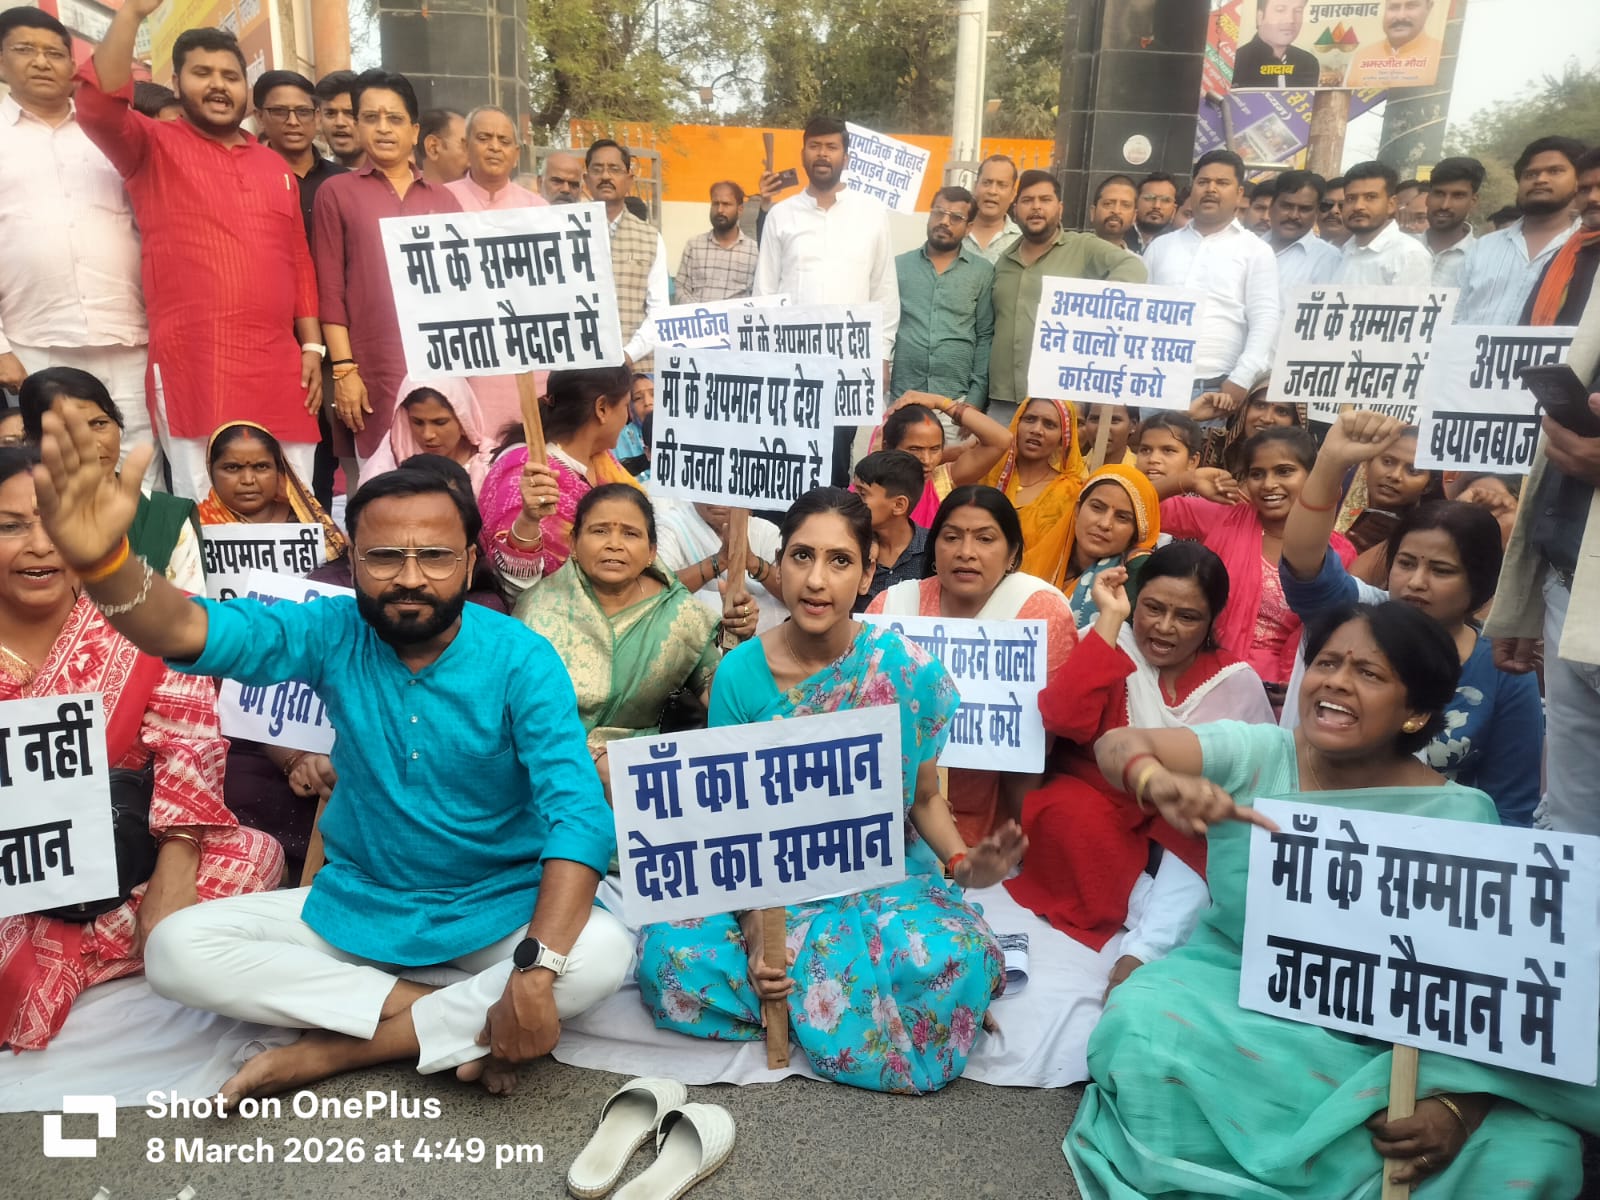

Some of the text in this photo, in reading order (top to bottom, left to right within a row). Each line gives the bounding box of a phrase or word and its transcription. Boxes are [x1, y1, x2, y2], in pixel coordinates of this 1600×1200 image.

[1310, 3, 1380, 23] मुबारकबाद
[400, 211, 596, 294] माँ के सम्मान में
[418, 293, 604, 371] जनता मैदान में
[826, 323, 843, 359] पर
[846, 311, 871, 359] देश
[1051, 288, 1196, 326] अमर्यादित बयान
[1294, 291, 1448, 344] माँ के सम्मान में
[1040, 321, 1069, 353] देने
[1072, 326, 1123, 357] वालों
[1123, 335, 1148, 360] पर
[661, 356, 824, 429] माँ के अपमान पर देश
[862, 368, 875, 416] है
[1058, 361, 1166, 398] कार्रवाई करो
[1284, 350, 1430, 400] जनता मैदान में
[656, 428, 823, 501] की जनता आक्रोशित है
[205, 528, 319, 574] अपमान नहीं
[950, 626, 991, 681] करने
[994, 626, 1039, 682] वालों
[18, 699, 94, 782] नहीं
[988, 692, 1023, 748] करो
[628, 733, 883, 820] माँ का सम्मान
[628, 812, 893, 901] देश का सम्मान
[1270, 814, 1575, 945] माँ के सम्मान में
[1267, 934, 1566, 1065] जनता मैदान में
